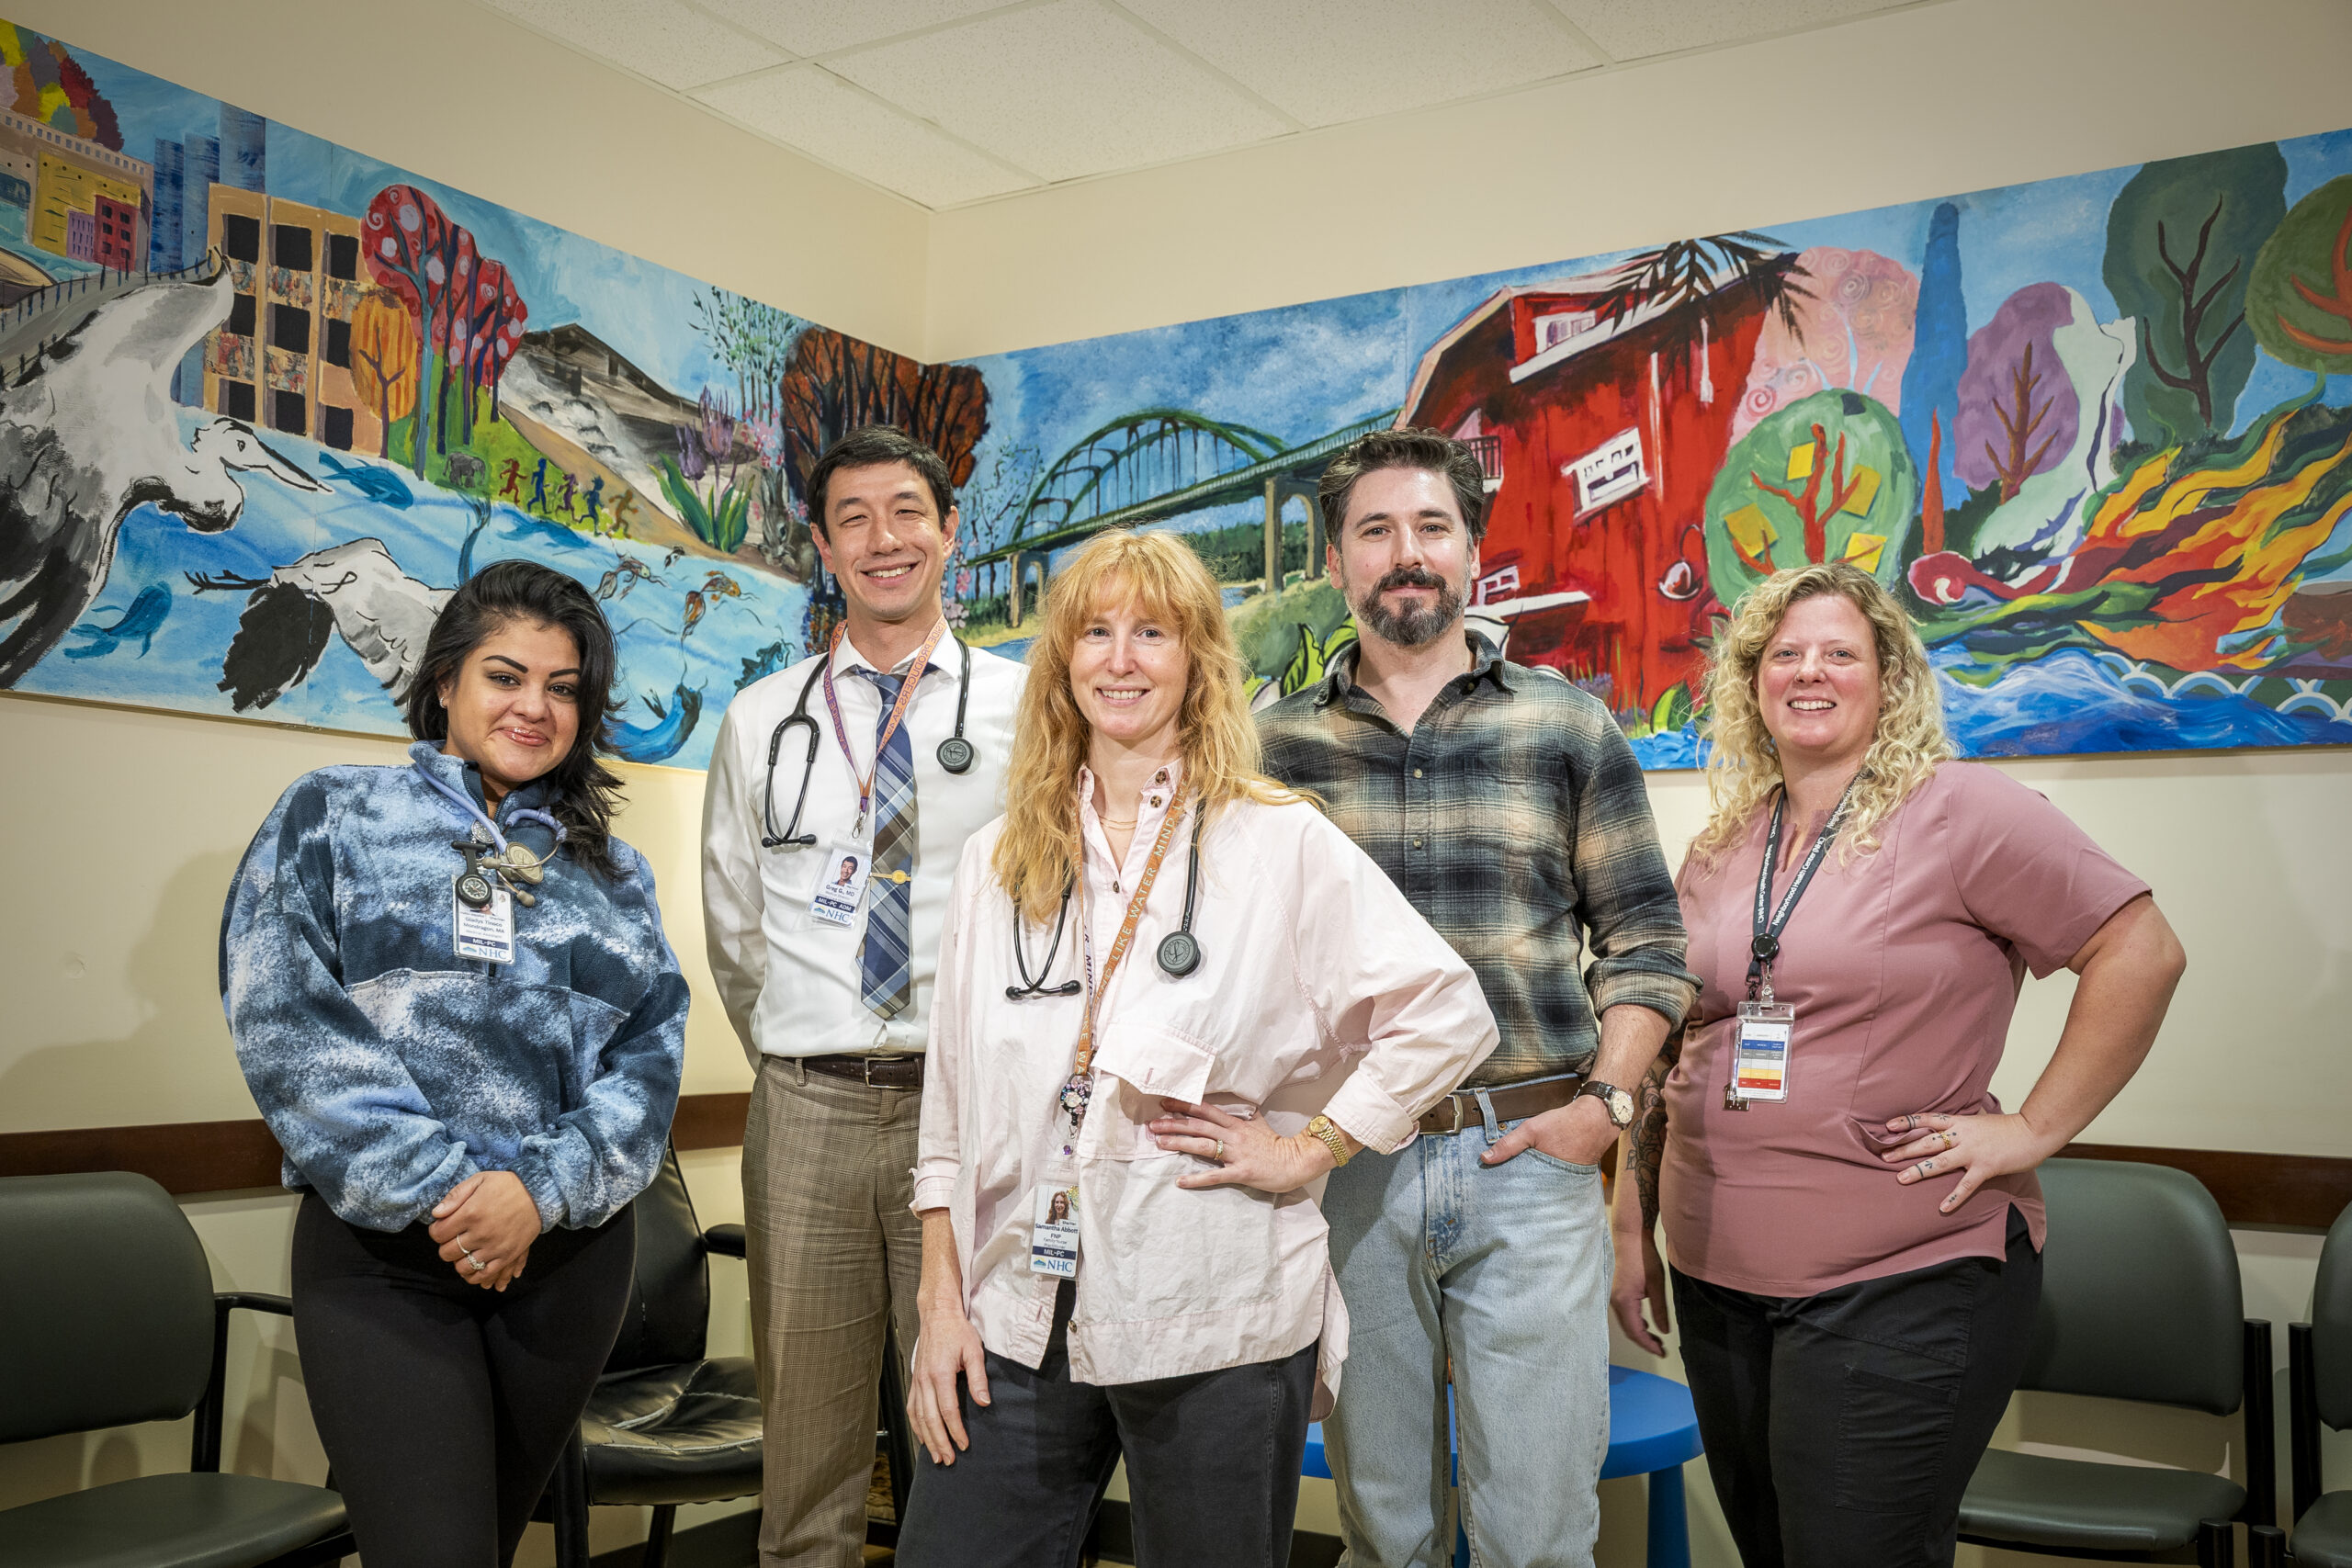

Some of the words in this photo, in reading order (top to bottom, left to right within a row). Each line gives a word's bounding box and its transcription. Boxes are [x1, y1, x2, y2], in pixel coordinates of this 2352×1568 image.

[1772, 886, 1797, 926] Neighborhood
[1792, 869, 1807, 888] Health
[1802, 852, 1816, 870] Center
[1813, 836, 1826, 853] (NHC)
[826, 885, 838, 893] Greg
[1112, 926, 1133, 961] LIKE
[1128, 866, 1157, 919] WATER
[1154, 818, 1176, 857] MIND
[839, 903, 852, 911] ADM
[826, 908, 850, 922] NHC
[479, 947, 507, 960] NHC
[1035, 1223, 1060, 1232] Samantha
[1060, 1225, 1078, 1234] Abbott
[1044, 1248, 1065, 1258] MIL-PC
[1047, 1259, 1073, 1273] NHC
